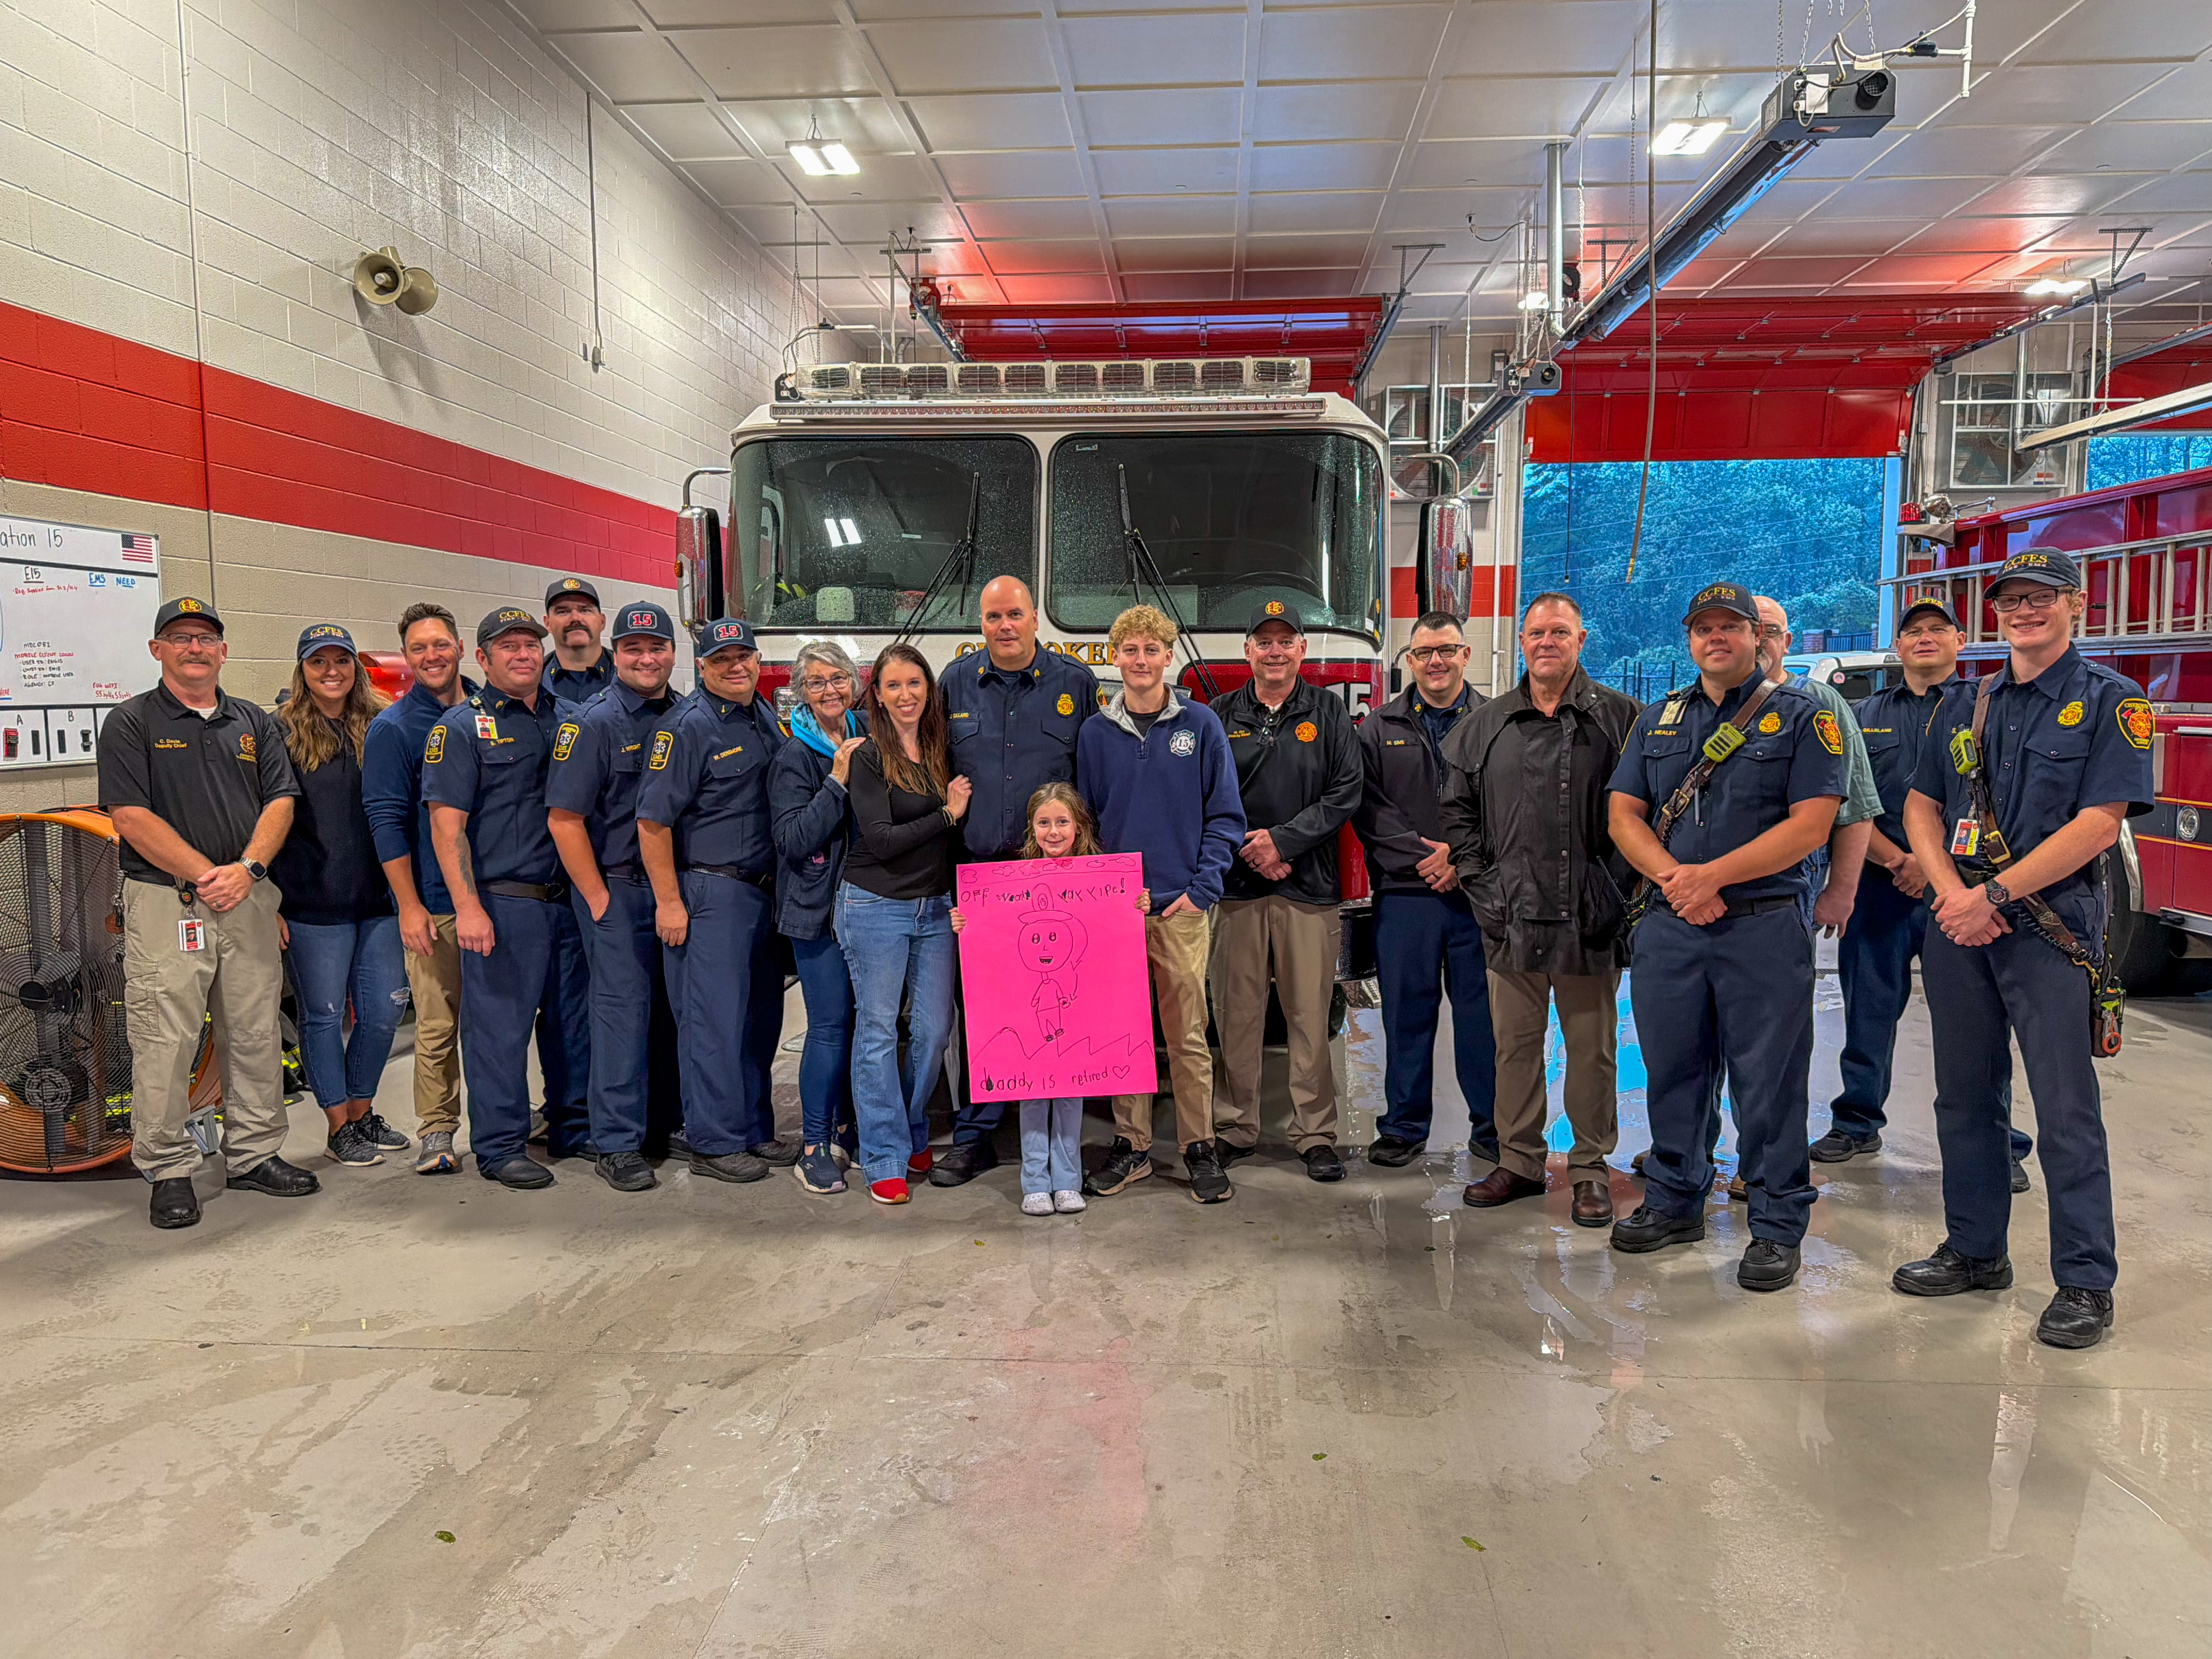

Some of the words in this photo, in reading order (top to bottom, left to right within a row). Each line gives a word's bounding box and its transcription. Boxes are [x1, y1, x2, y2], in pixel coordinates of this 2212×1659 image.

[48, 528, 63, 548] 15
[2004, 554, 2047, 569] CCFES
[24, 566, 41, 580] E15
[89, 573, 106, 584] EMS
[116, 577, 136, 585] NEED
[1698, 587, 1736, 601] CCFES
[1911, 597, 1943, 607] CCFES
[499, 610, 531, 620] CCFES
[632, 614, 652, 626] 15
[310, 627, 343, 636] CCFES
[718, 625, 738, 638] 15
[16, 714, 24, 726] A
[68, 711, 74, 722] B
[626, 743, 641, 752] WRIGHT
[1178, 738, 1189, 747] 15
[720, 746, 744, 758] DENSMORE
